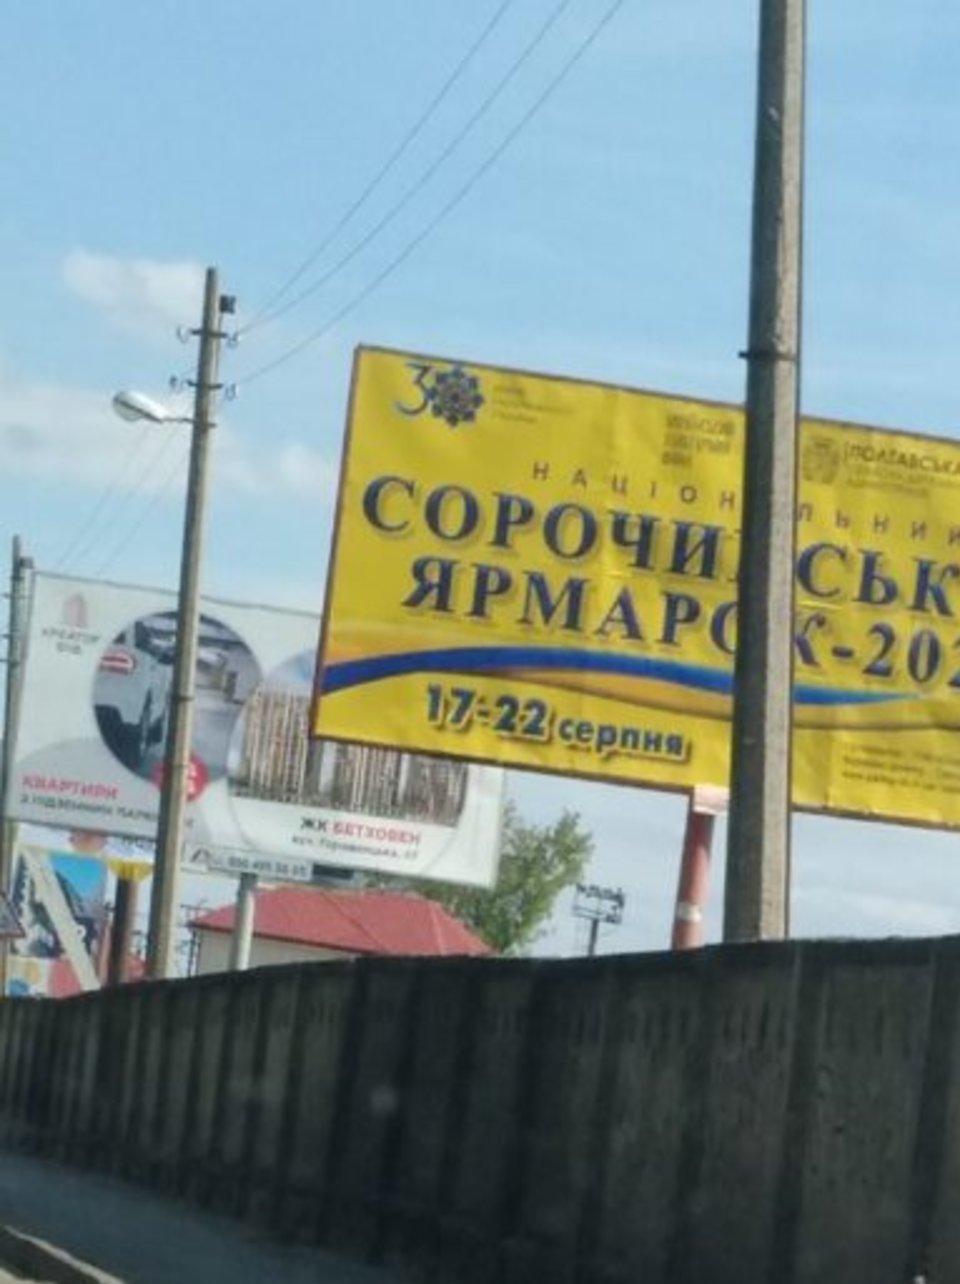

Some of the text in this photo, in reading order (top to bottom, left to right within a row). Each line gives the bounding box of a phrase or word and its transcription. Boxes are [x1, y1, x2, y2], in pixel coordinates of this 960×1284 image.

[426, 684, 690, 760] 17-22 серпня
[21, 774, 119, 799] КВАРТИРИ
[300, 816, 421, 845] ЖК БЕТХОВЕН
